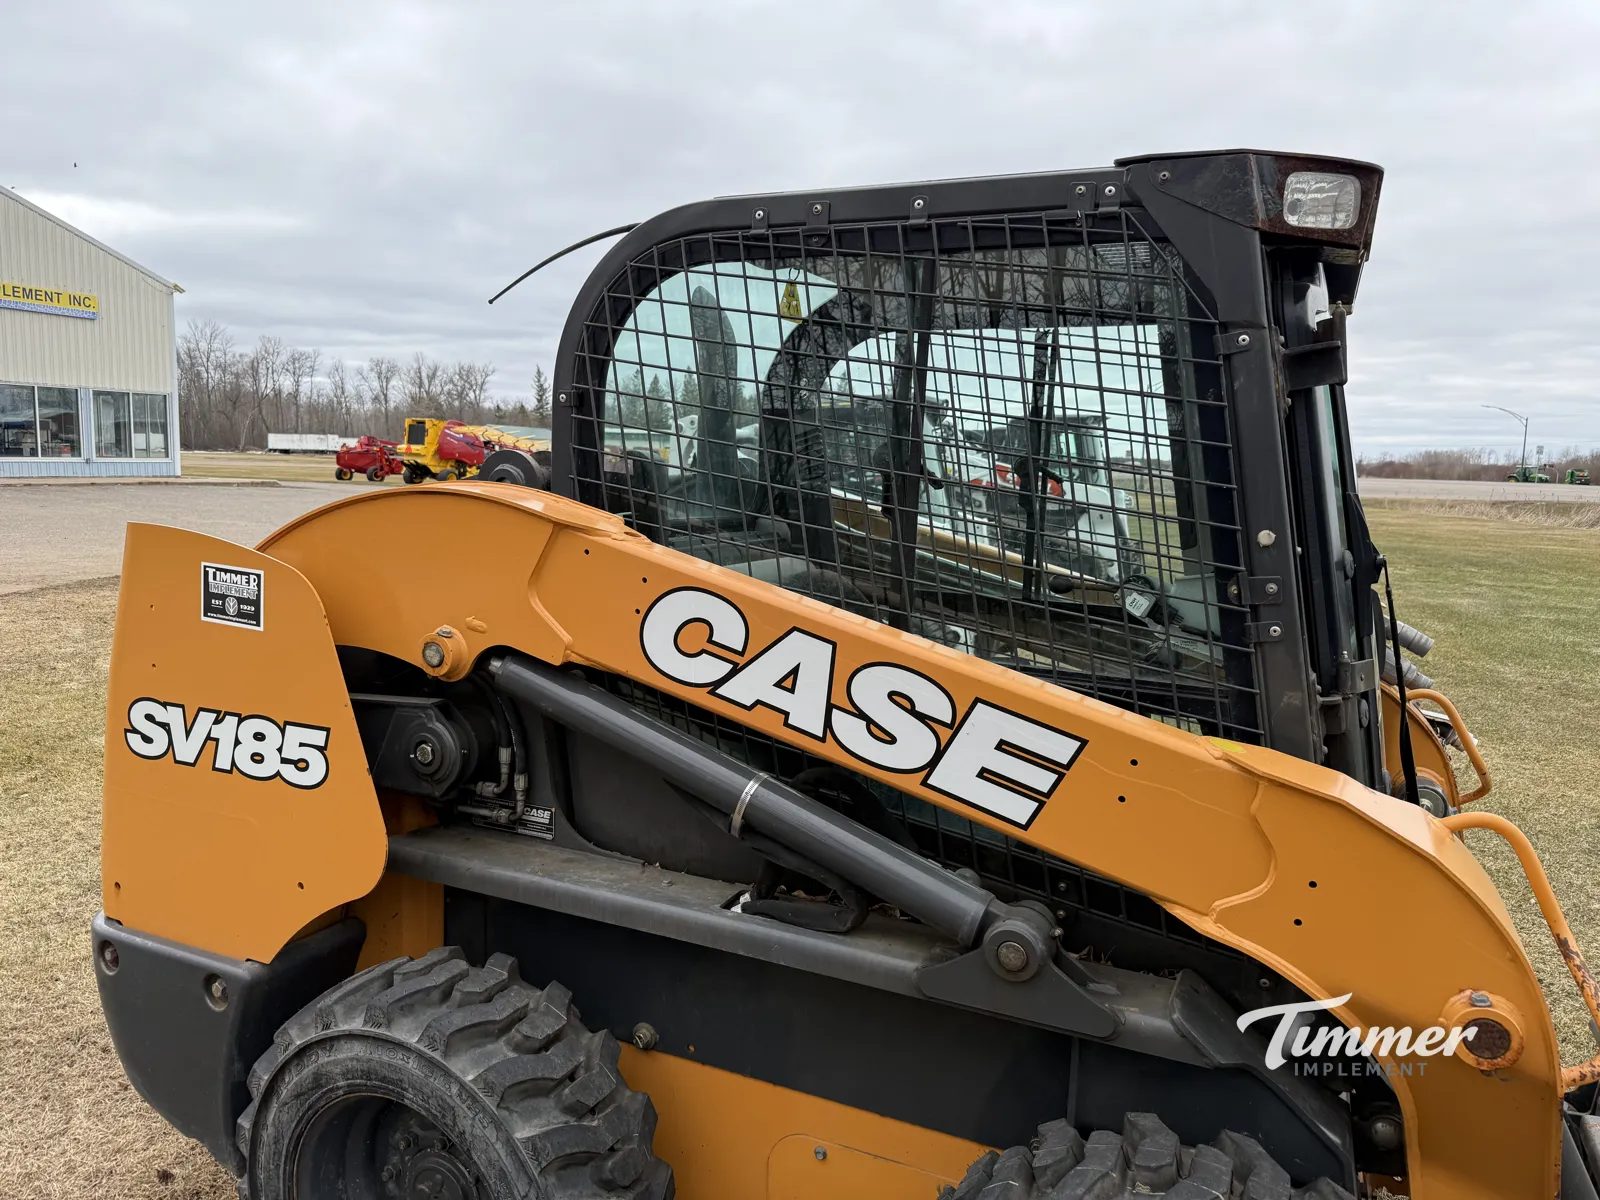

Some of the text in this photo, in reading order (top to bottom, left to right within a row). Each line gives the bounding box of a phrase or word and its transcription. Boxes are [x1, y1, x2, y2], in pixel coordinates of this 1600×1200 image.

[0, 284, 96, 309] LEMENT INC.
[205, 567, 258, 590] TIMMER
[208, 582, 258, 599] IMPLEMENT
[640, 585, 1089, 831] CASE
[124, 696, 331, 790] SV185
[523, 806, 552, 819] CASE
